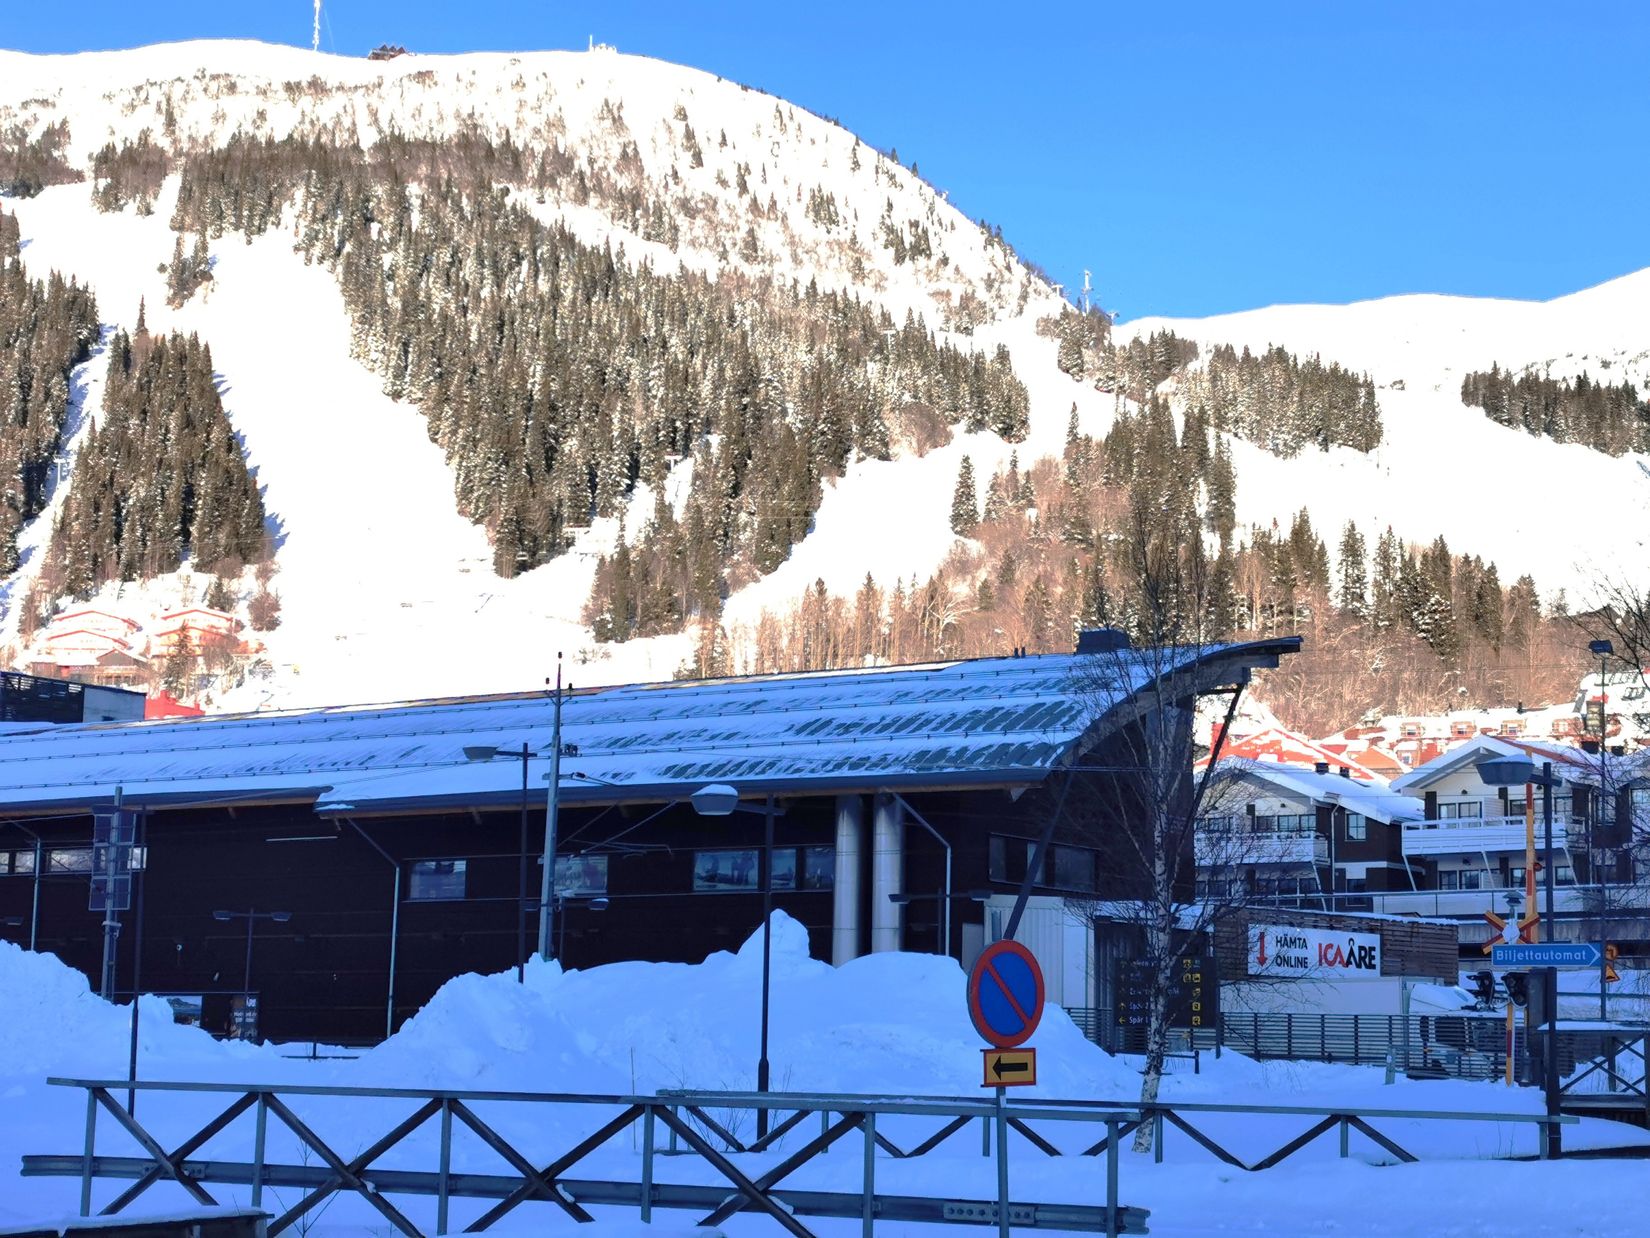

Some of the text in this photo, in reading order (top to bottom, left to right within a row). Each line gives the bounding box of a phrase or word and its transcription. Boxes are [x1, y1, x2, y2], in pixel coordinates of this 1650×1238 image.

[1275, 934, 1308, 950] HÄMTA
[1318, 938, 1376, 969] ICA ÅRE
[1496, 950, 1586, 962] Biljettautomat
[1275, 955, 1308, 969] ONLINE
